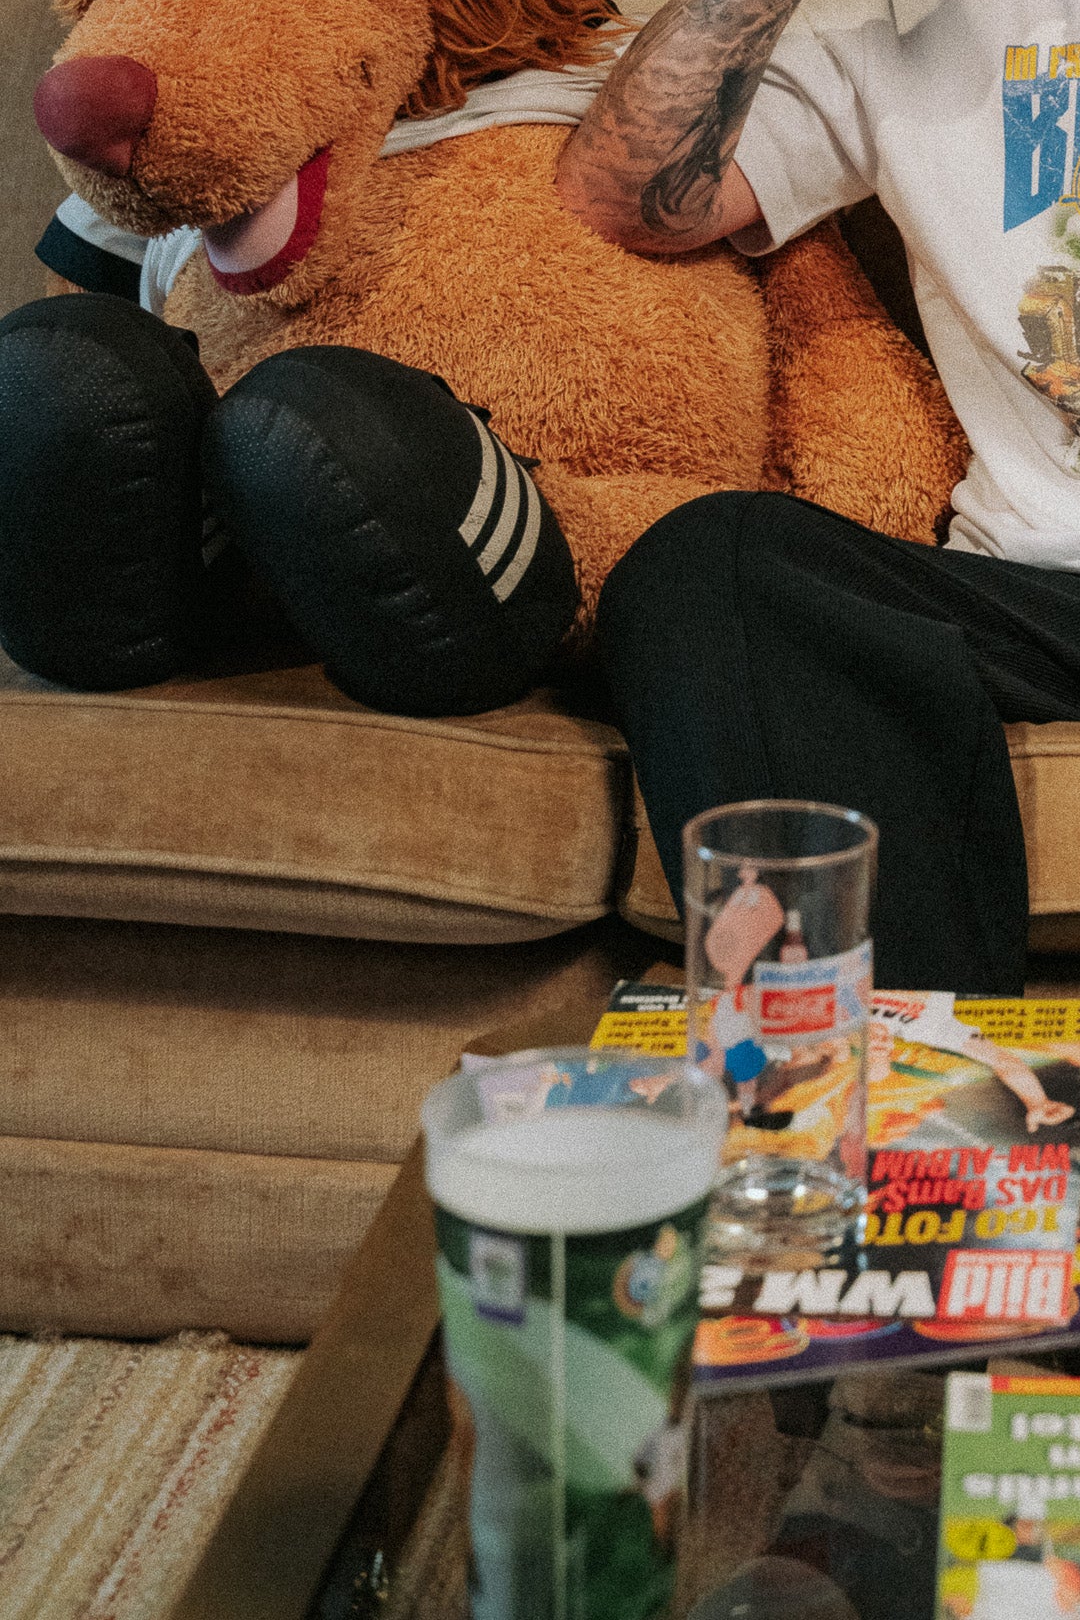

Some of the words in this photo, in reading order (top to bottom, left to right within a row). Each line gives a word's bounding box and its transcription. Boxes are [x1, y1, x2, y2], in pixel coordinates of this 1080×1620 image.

[870, 1141, 1071, 1182] WM-ALBUM
[975, 1205, 1061, 1240] 160
[752, 1269, 937, 1318] WM
[947, 1263, 1065, 1320] Bild
